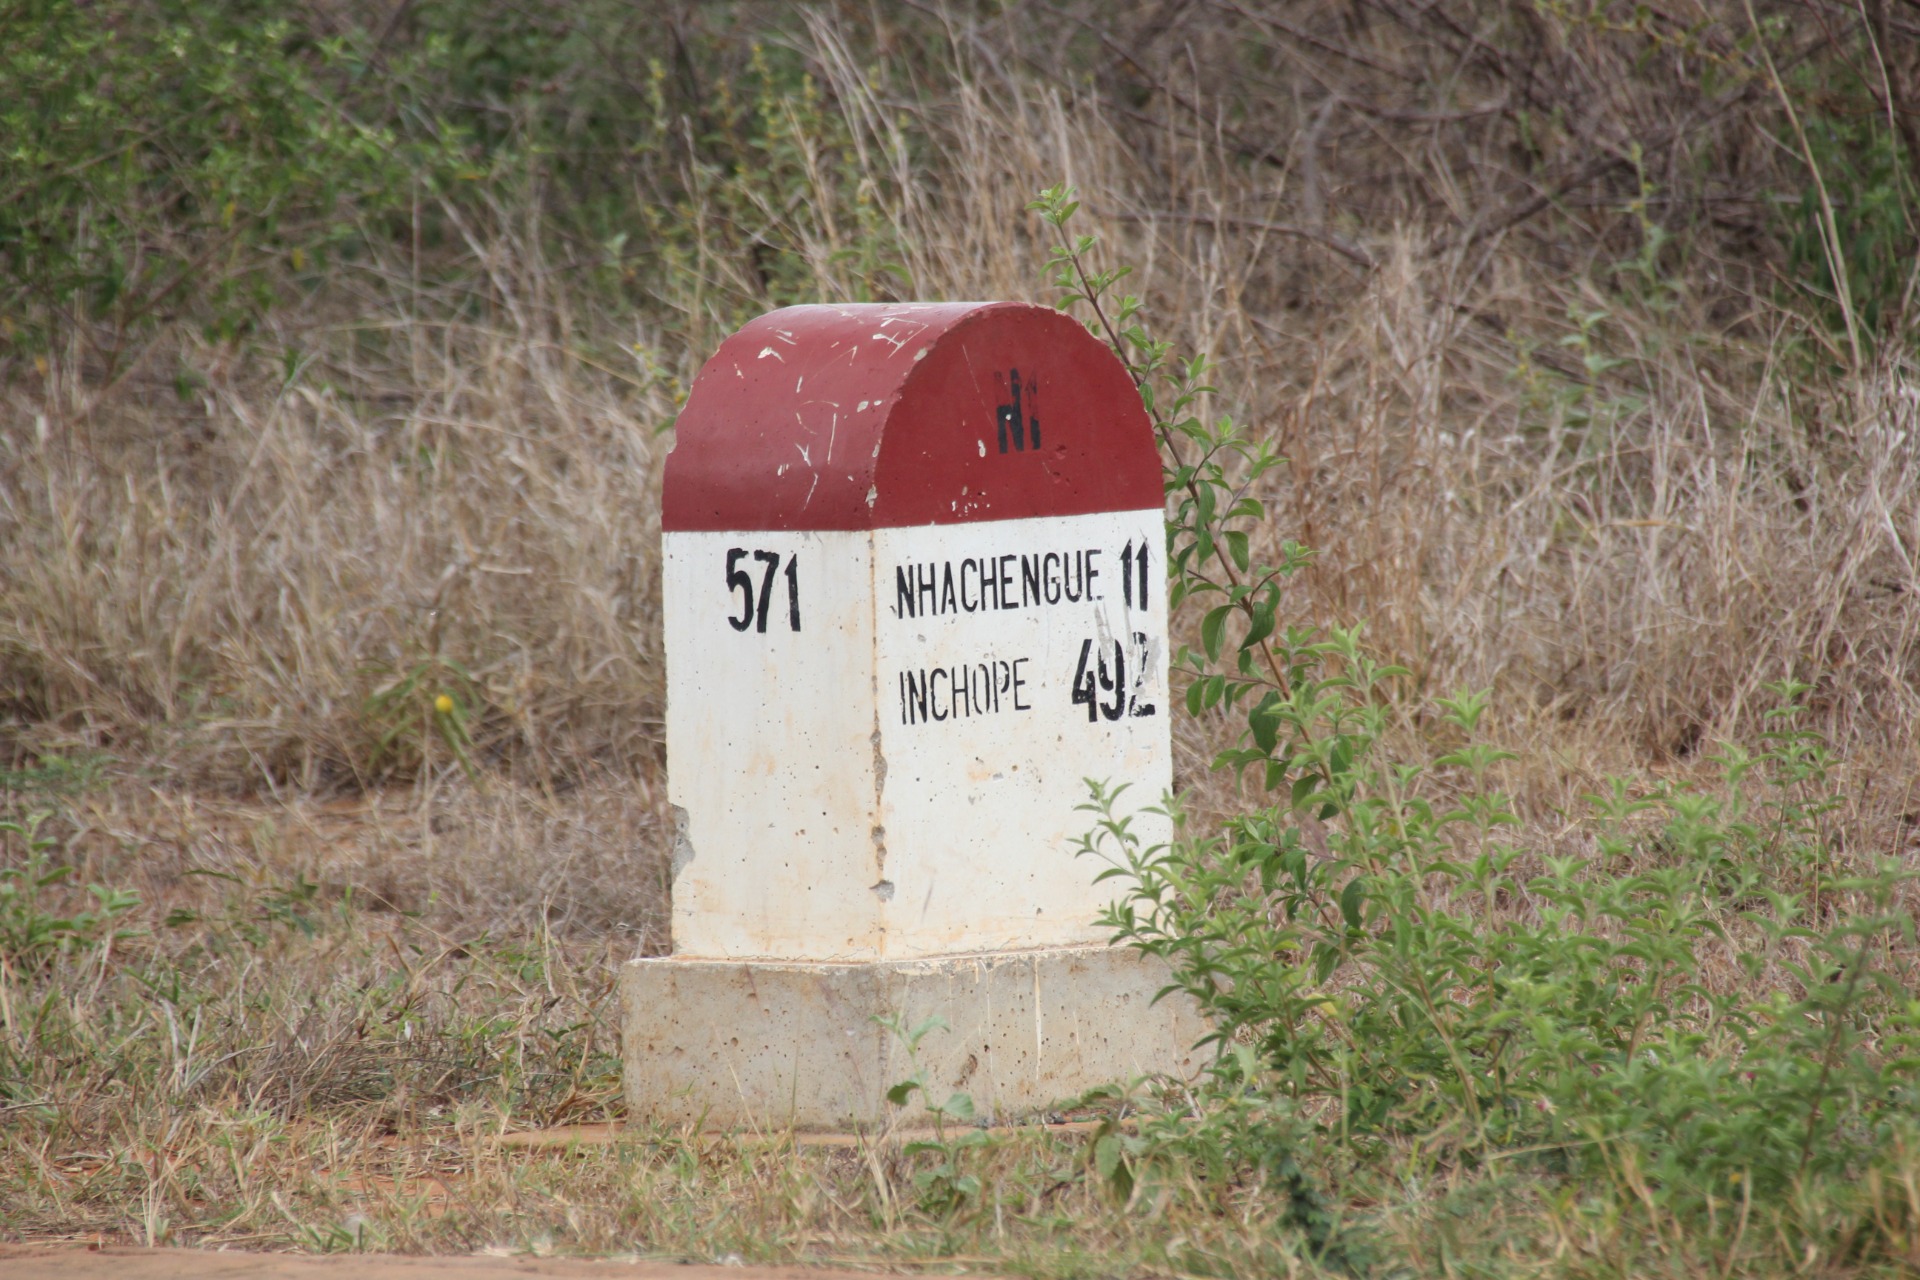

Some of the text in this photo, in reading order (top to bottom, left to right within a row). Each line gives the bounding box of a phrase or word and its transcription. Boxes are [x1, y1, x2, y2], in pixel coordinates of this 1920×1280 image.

[725, 547, 801, 633] 571
[895, 538, 1148, 619] NHACHENGUE 11
[899, 632, 1155, 725] INCHOPE 492
